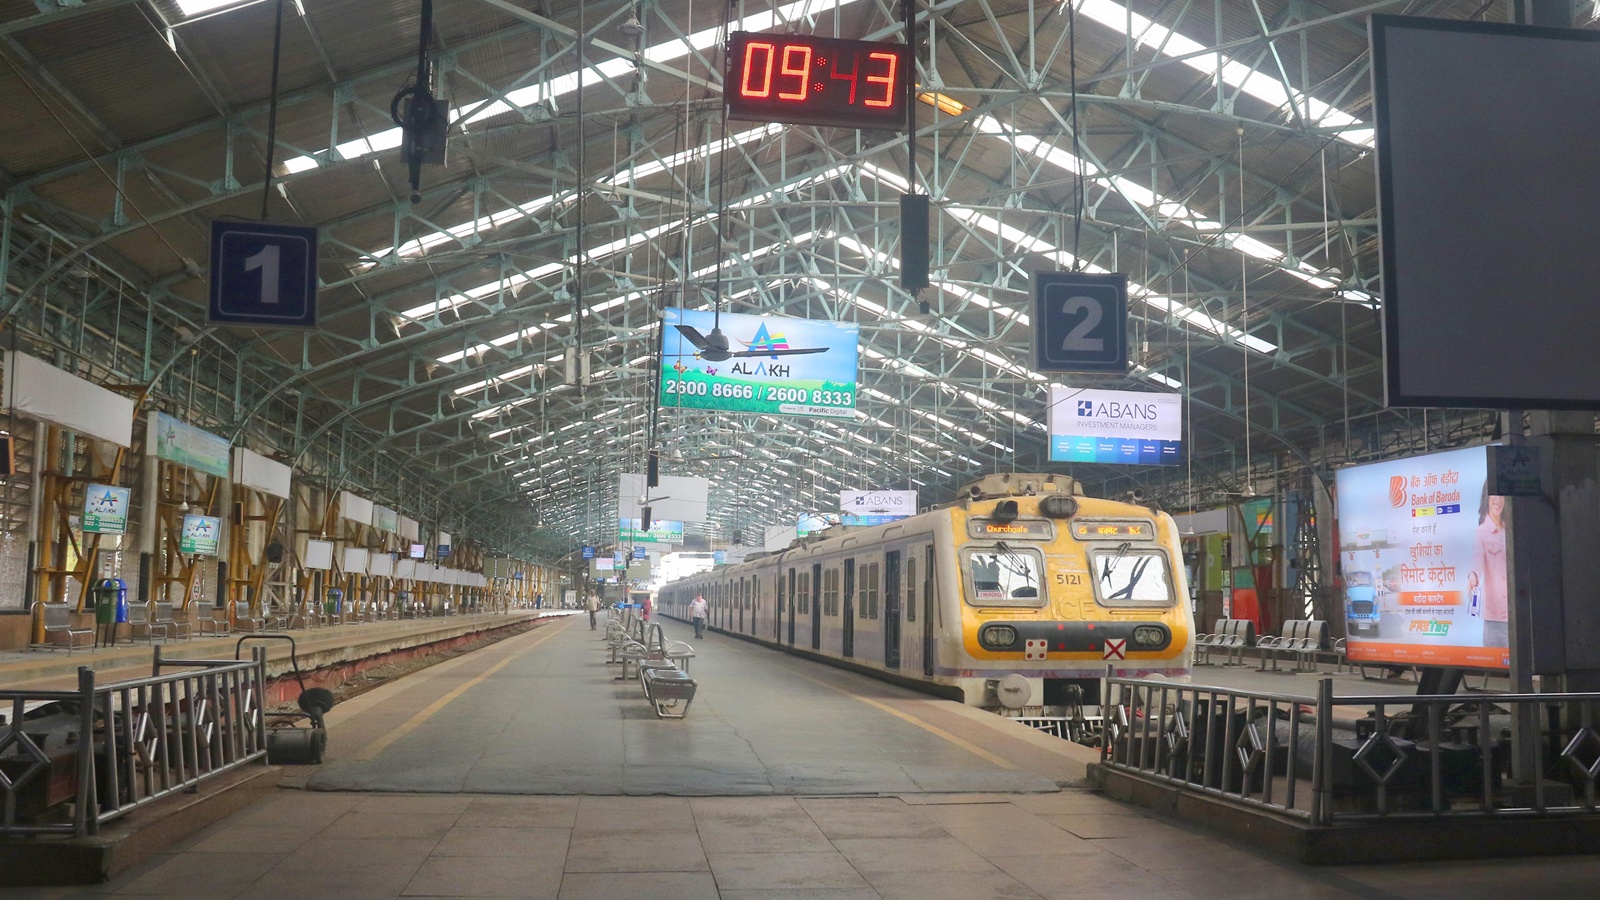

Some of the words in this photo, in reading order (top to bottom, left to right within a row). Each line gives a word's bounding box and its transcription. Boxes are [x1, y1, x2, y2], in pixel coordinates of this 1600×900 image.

[741, 42, 897, 107] 09:43
[245, 244, 280, 303] 1
[1061, 296, 1104, 351] 2
[731, 361, 790, 378] ALAKH
[665, 380, 707, 396] 2600
[712, 382, 753, 399] 8666
[767, 386, 807, 403] 2600
[812, 391, 852, 406] 8333
[1095, 402, 1157, 420] ABANS
[1076, 420, 1118, 429] INVESTMENT
[1119, 422, 1157, 431] MANAGERS
[866, 496, 903, 505] ABANS
[1411, 492, 1428, 506] Bank
[1429, 491, 1435, 504] of
[1436, 489, 1460, 503] Baroda
[986, 524, 1028, 533] Churchgate
[1409, 541, 1432, 562] खुशियों
[1433, 545, 1443, 556] का
[1056, 574, 1081, 585] 5121
[1400, 562, 1425, 583] रिमोट
[1427, 561, 1456, 587] कंट्रोल
